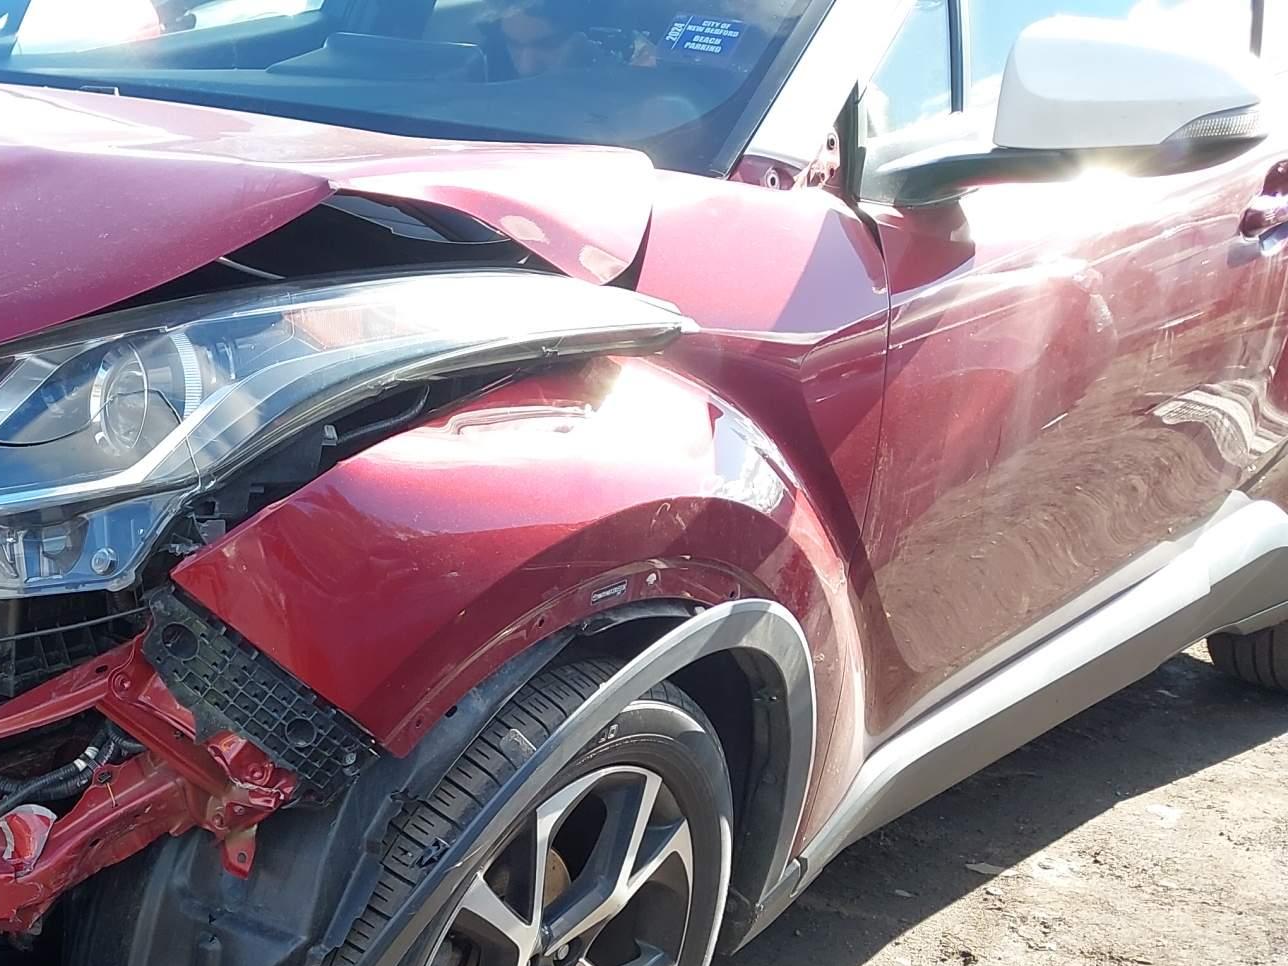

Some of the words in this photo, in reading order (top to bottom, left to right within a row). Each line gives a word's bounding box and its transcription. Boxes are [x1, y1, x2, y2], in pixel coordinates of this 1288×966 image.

[665, 23, 685, 41] 2024
[704, 27, 739, 37] BEDFORD
[693, 35, 722, 44] BEACH
[683, 42, 722, 53] PARKING
